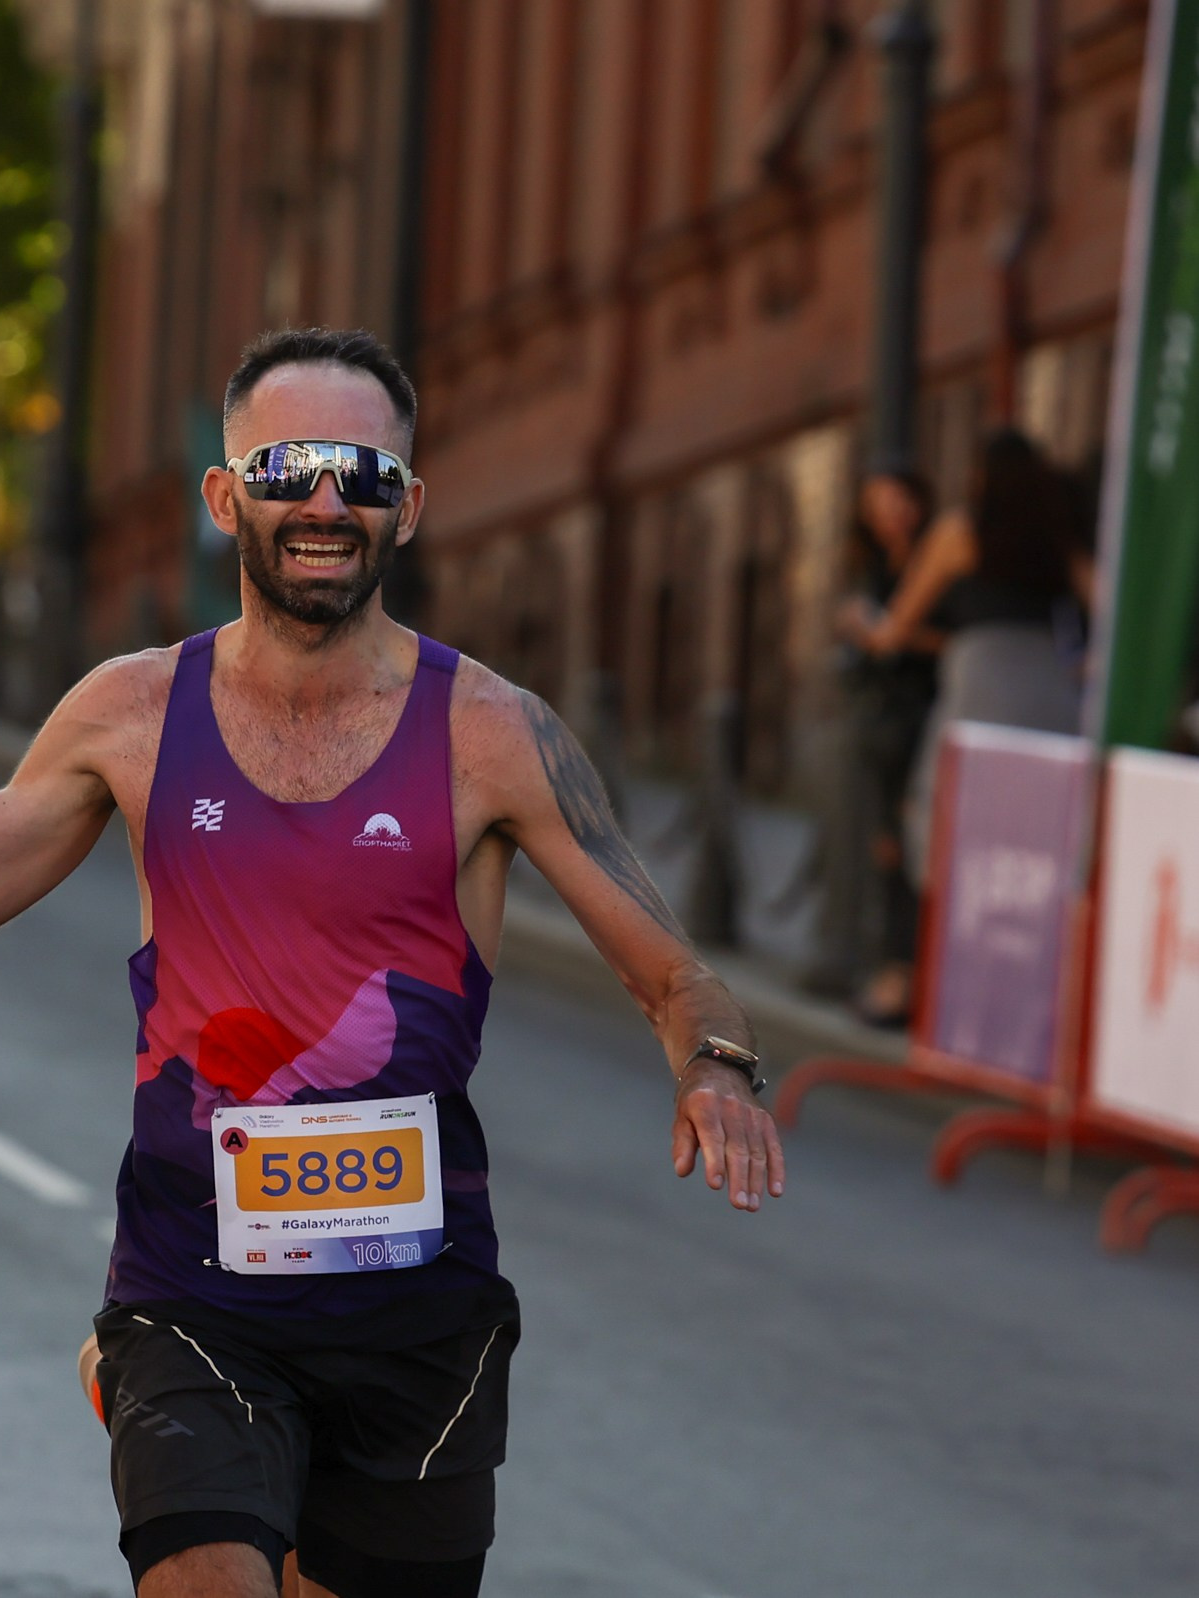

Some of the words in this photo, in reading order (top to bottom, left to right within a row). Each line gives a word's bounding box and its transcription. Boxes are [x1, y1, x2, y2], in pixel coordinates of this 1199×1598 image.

[301, 1115, 328, 1125] DNS
[225, 1132, 243, 1148] A
[260, 1146, 403, 1197] 5889
[281, 1215, 390, 1230] #GalaxyMarathon
[352, 1240, 421, 1266] 10km
